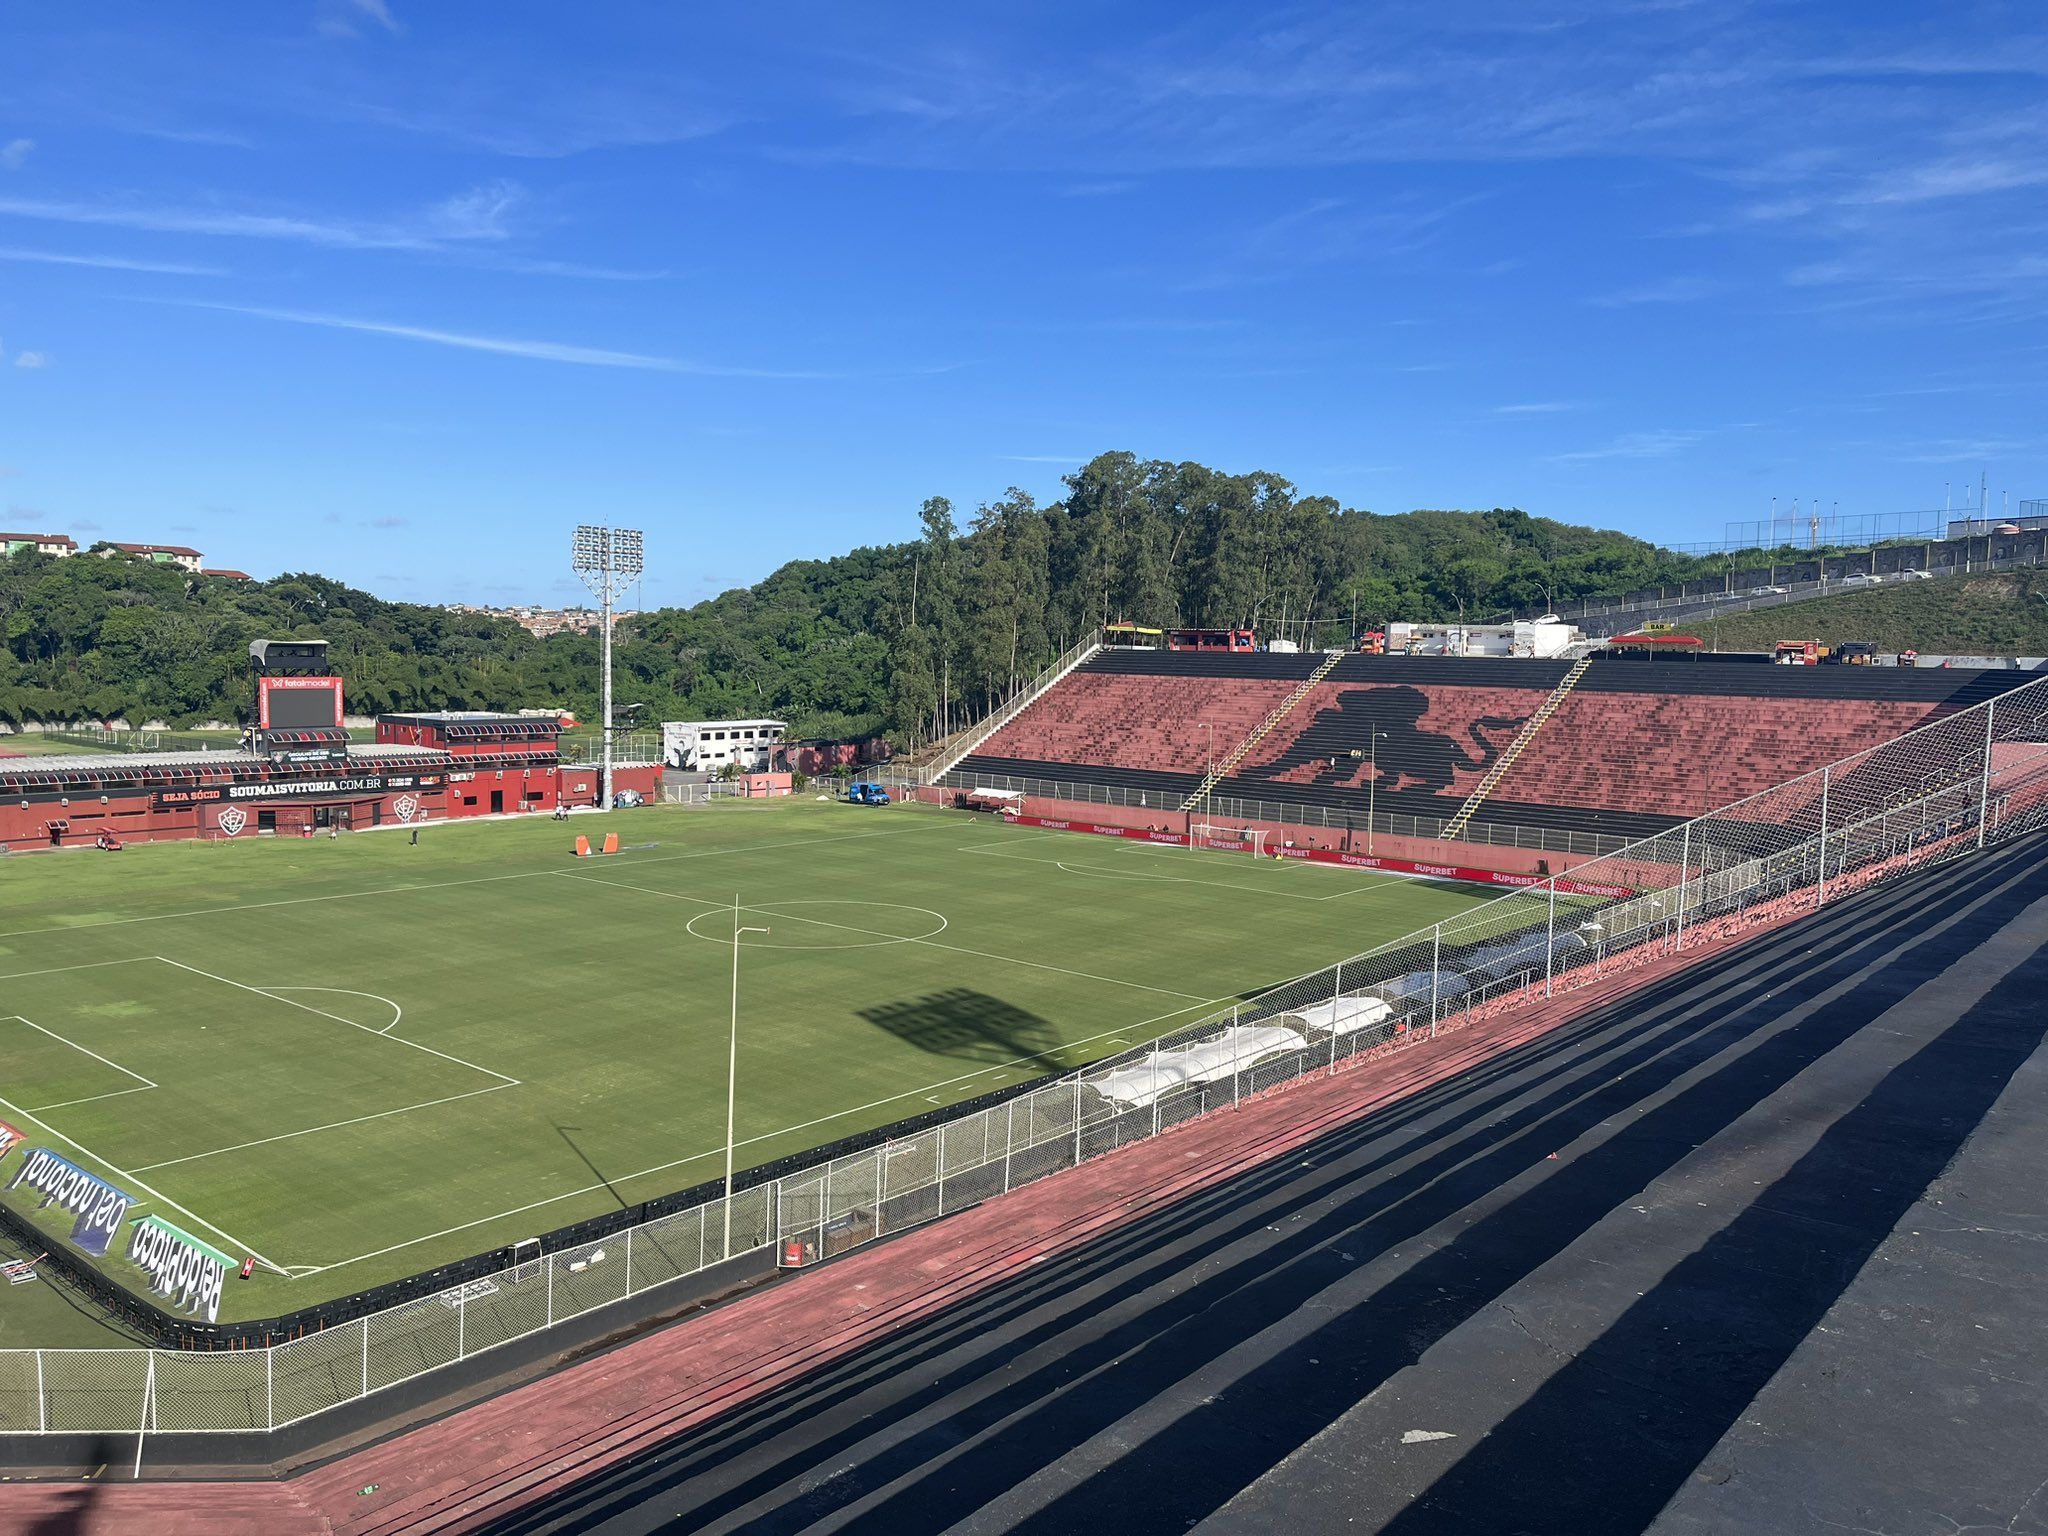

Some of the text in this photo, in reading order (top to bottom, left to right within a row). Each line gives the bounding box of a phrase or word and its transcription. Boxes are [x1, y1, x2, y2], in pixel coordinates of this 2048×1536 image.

[285, 679, 330, 687] fatalmodel
[229, 778, 381, 797] SOUMAISVITORIA.COM.BR
[162, 789, 220, 802] SEJA SÓCIO
[1040, 819, 1069, 829] SUPERBET
[1093, 825, 1124, 835] SUPERBET
[1149, 832, 1182, 842] SUPERBET
[1209, 839, 1244, 849] SUPERBET
[1273, 845, 1310, 857] SUPERBET
[1341, 854, 1381, 866] SUPERBET
[1414, 863, 1457, 875] SUPERBET
[1492, 872, 1538, 885] SUPERBET
[1576, 882, 1622, 896] SUPERBET
